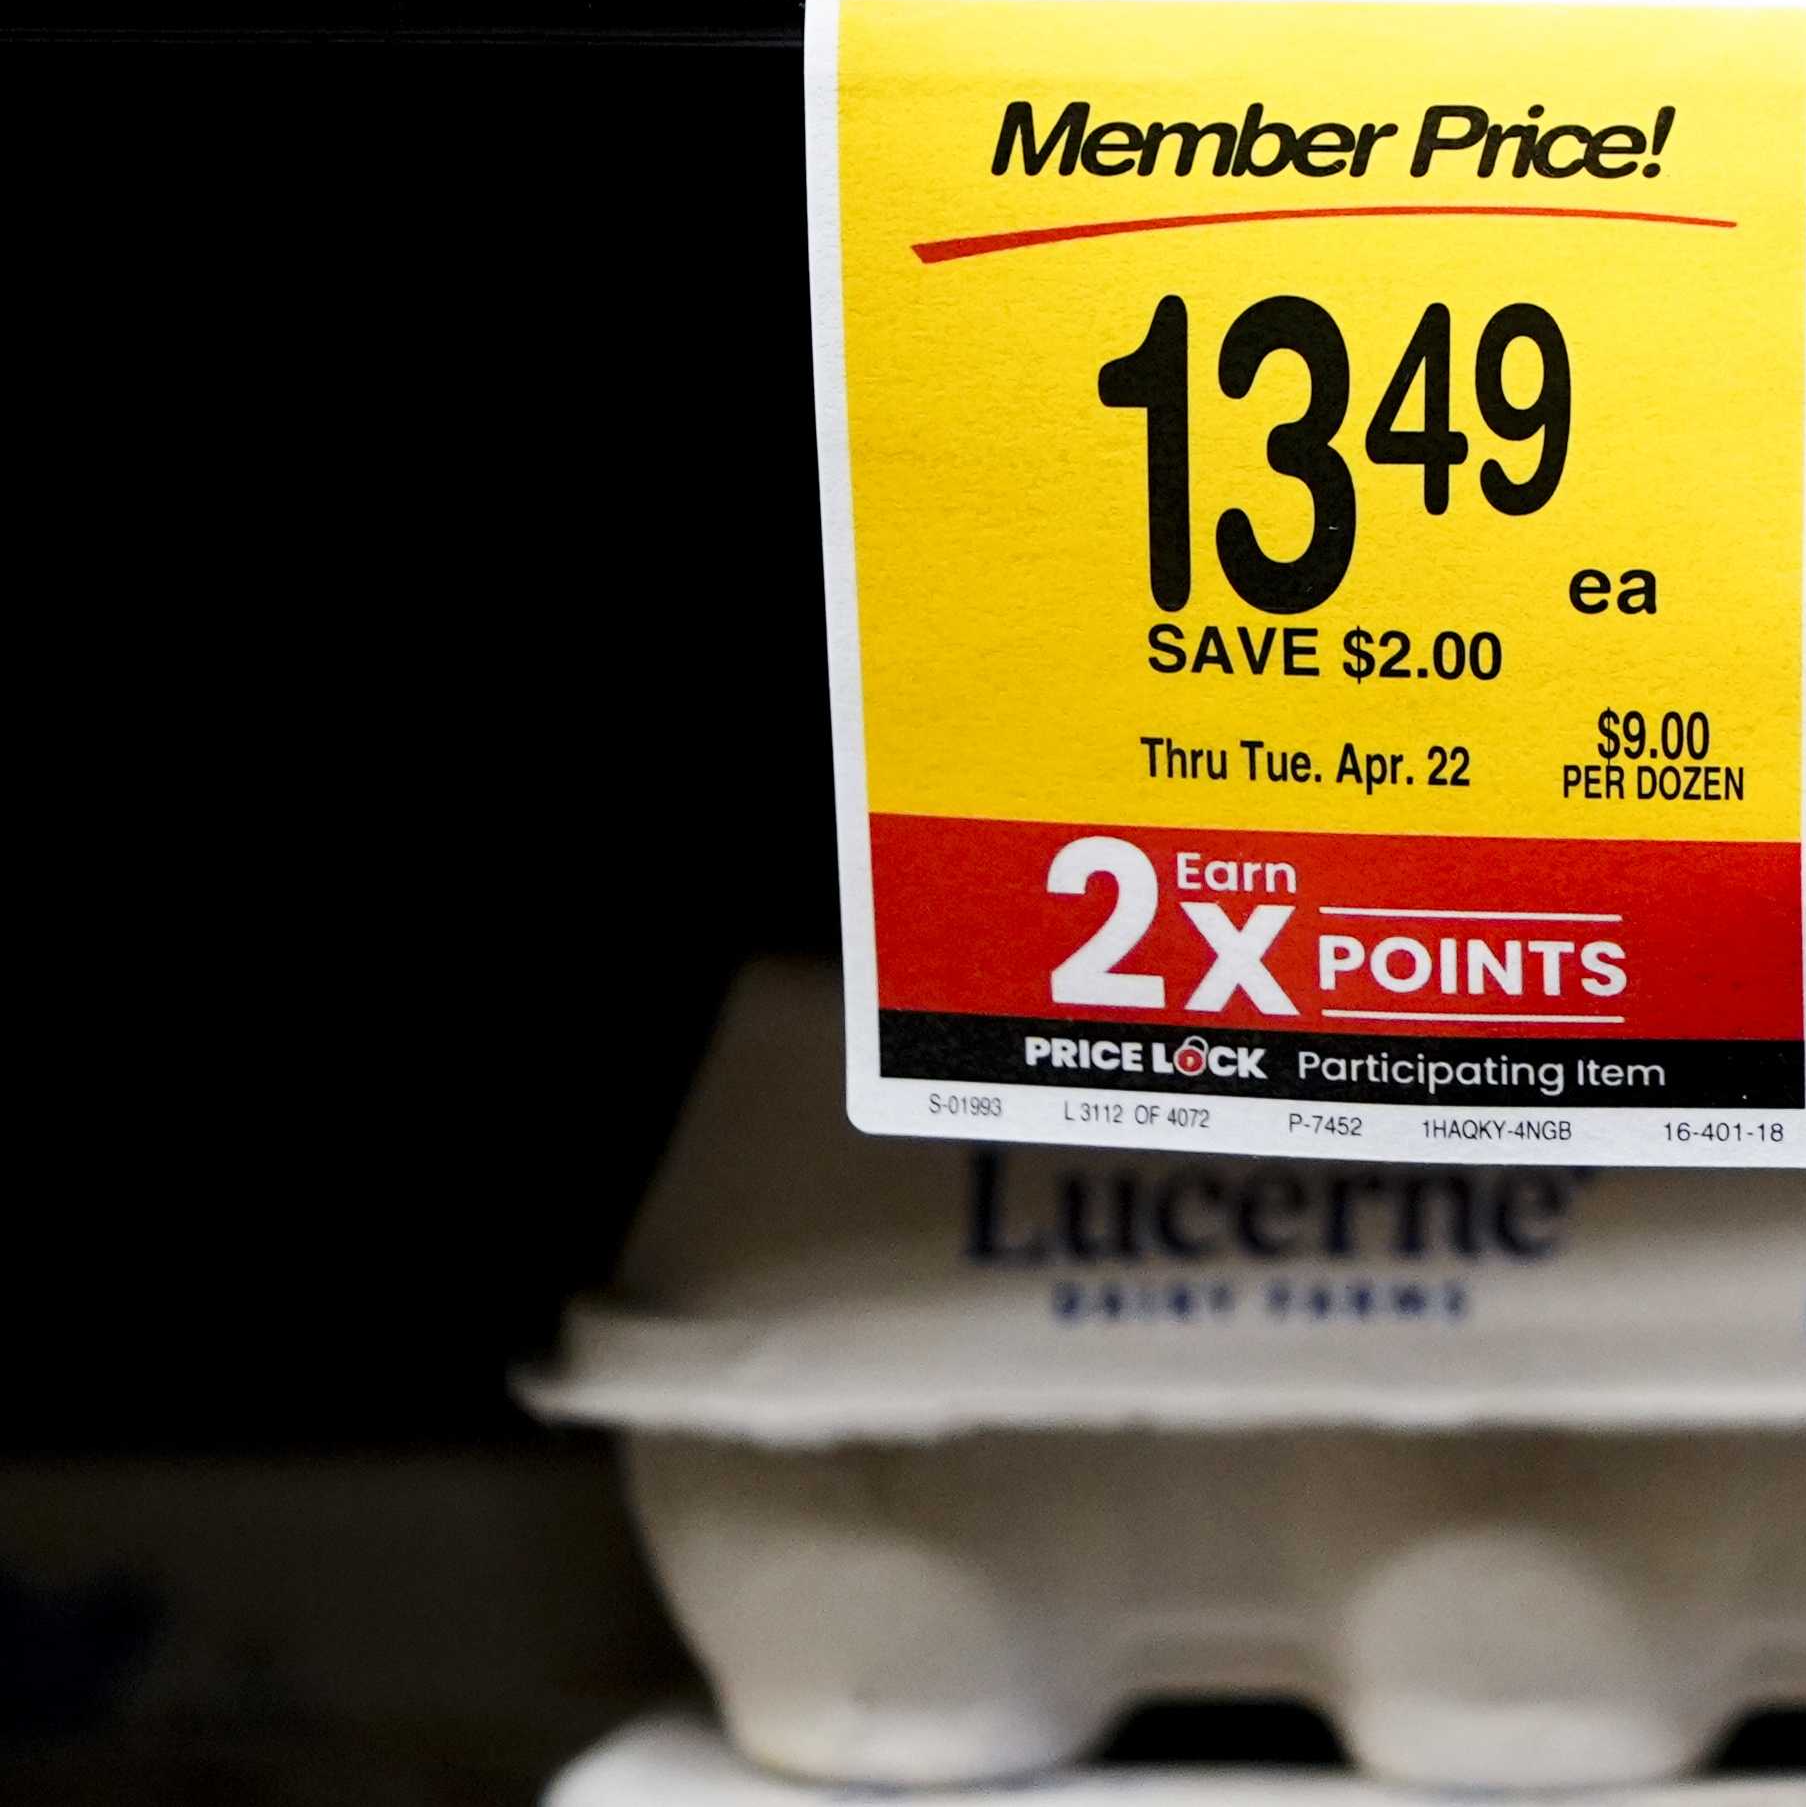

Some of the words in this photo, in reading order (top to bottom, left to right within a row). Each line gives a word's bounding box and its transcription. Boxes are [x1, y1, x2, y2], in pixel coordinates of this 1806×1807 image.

[991, 101, 1399, 178] Member
[1409, 104, 1676, 179] Price!
[1569, 568, 1657, 615] ea
[1148, 623, 1320, 677] SAVE
[1342, 625, 1502, 685] $2.00
[1597, 707, 1710, 765] $9.00
[1140, 736, 1228, 780] Thru
[1239, 740, 1322, 783] Tue.
[1336, 742, 1414, 795] Apr.
[1427, 745, 1470, 787] 22
[1563, 761, 1625, 800] PER
[1637, 765, 1744, 801] DOZEN
[1176, 851, 1297, 894] Earn
[1318, 934, 1627, 997] POINTS
[1025, 1036, 1144, 1072] PRICE
[1298, 1051, 1564, 1096] Participating
[1577, 1059, 1665, 1086] Item
[928, 1093, 1002, 1117] S-01993
[1080, 1102, 1123, 1124] 3112
[1134, 1104, 1160, 1125] OF
[1167, 1107, 1210, 1128] 4072
[1289, 1113, 1363, 1136] P-7452
[1423, 1119, 1572, 1141] 1HAQKY-4NGB
[1664, 1122, 1784, 1143] 16-401-18
